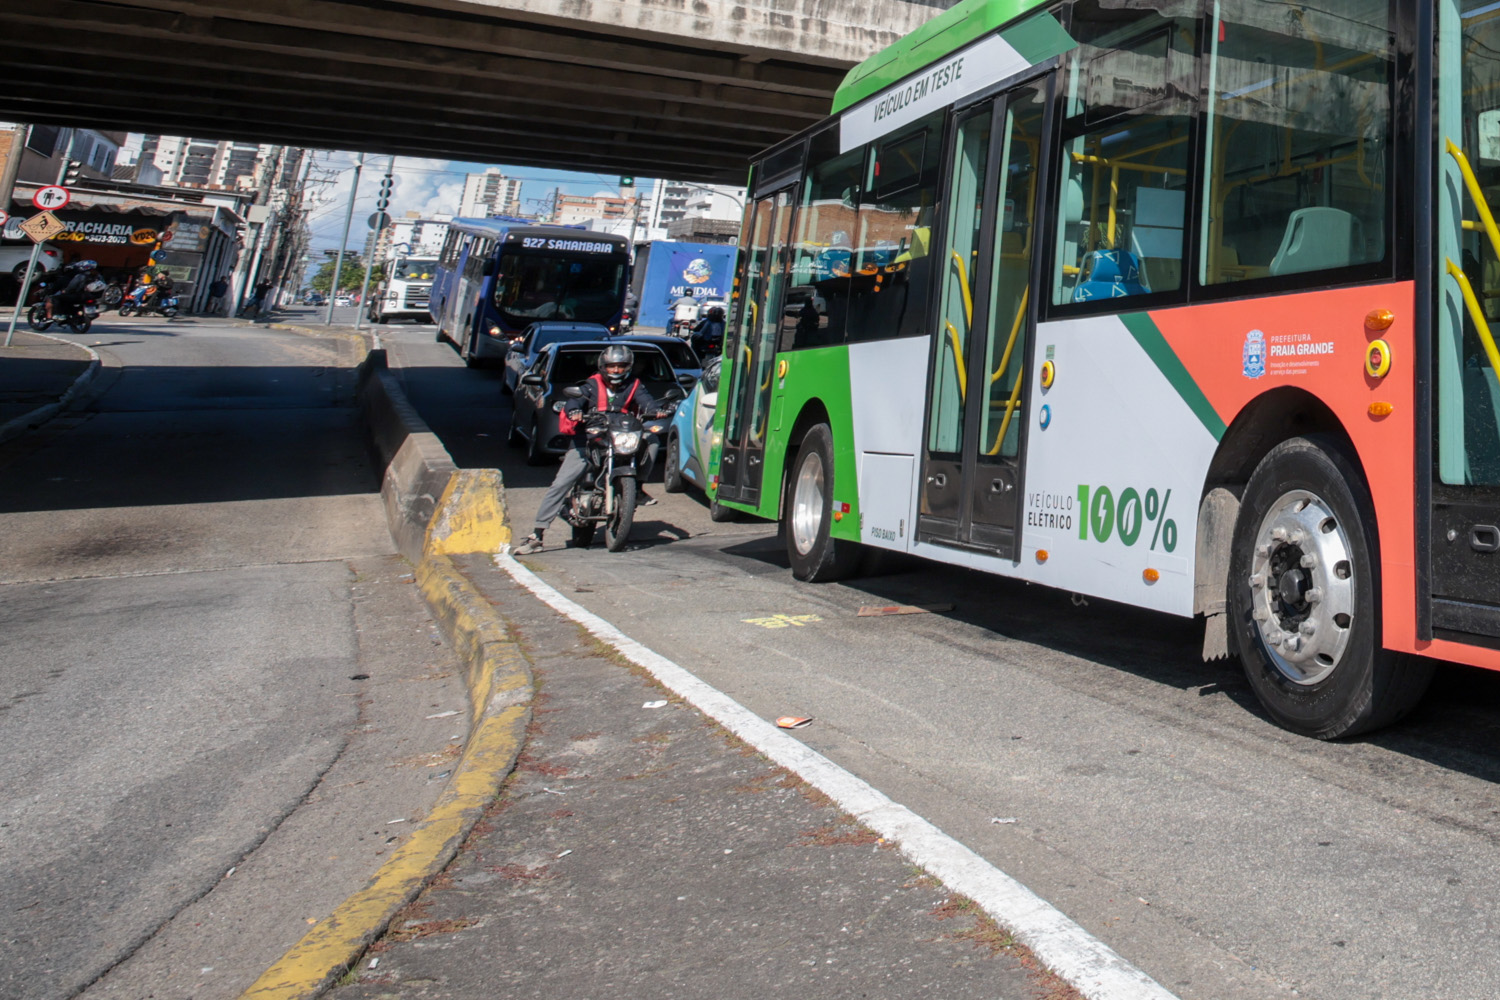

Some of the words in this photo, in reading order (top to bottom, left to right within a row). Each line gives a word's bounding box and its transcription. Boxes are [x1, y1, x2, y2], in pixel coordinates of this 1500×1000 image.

[874, 86, 912, 122] VEÍCULO
[913, 76, 930, 101] EM
[931, 57, 964, 92] TESTE
[61, 221, 133, 235] RACHARIA
[522, 237, 545, 249] 927
[548, 239, 613, 254] SAMAMBAIA
[1271, 334, 1311, 343] PREFEITURA
[1271, 345, 1296, 356] PRAIA
[1297, 342, 1334, 355] GRANDE
[1028, 509, 1071, 530] ELÉTRICO
[1029, 490, 1072, 510] VEÍCULO
[1077, 484, 1177, 553] 100%
